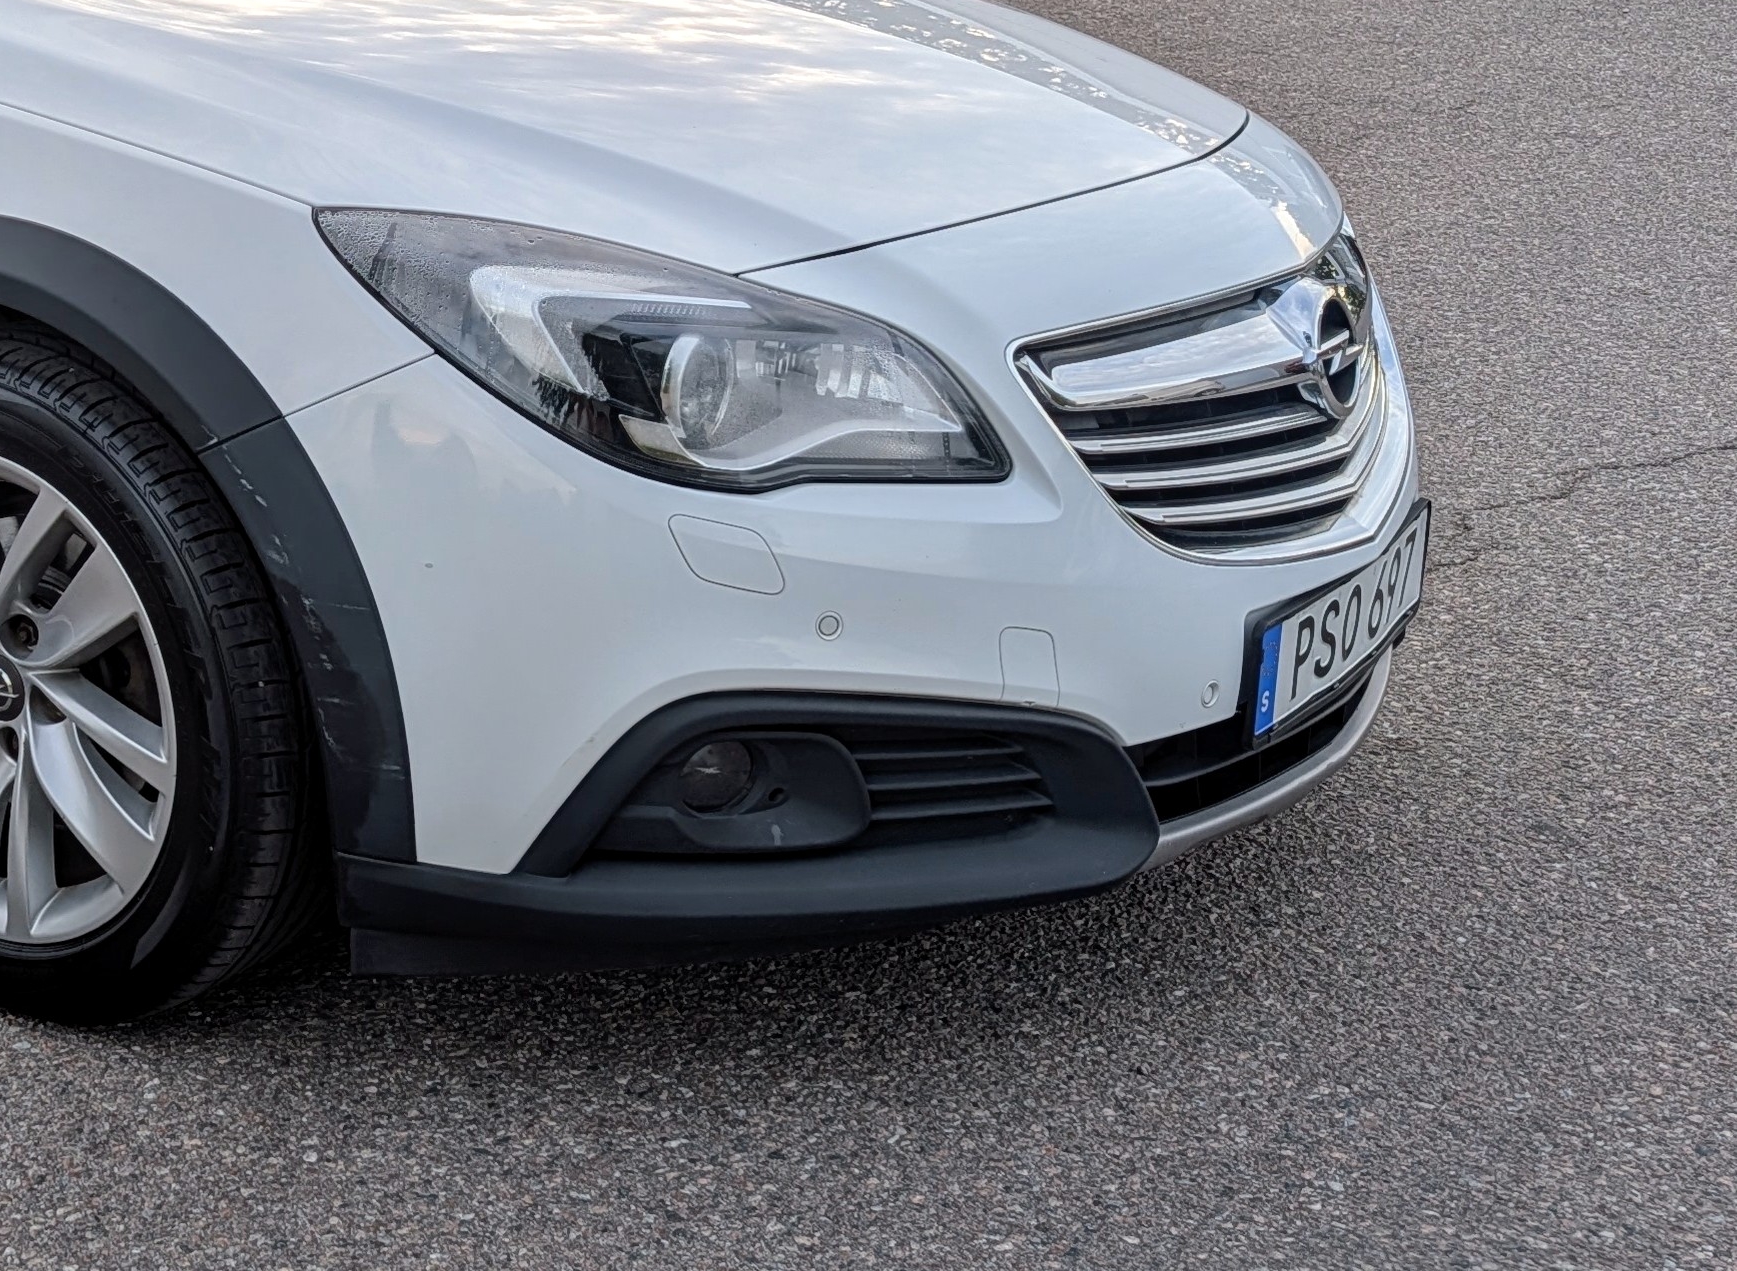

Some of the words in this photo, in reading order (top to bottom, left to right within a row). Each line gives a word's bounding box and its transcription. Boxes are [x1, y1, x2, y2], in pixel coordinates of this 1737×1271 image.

[1290, 583, 1362, 702] PSO
[1367, 528, 1419, 640] 697
[1261, 690, 1270, 714] S
